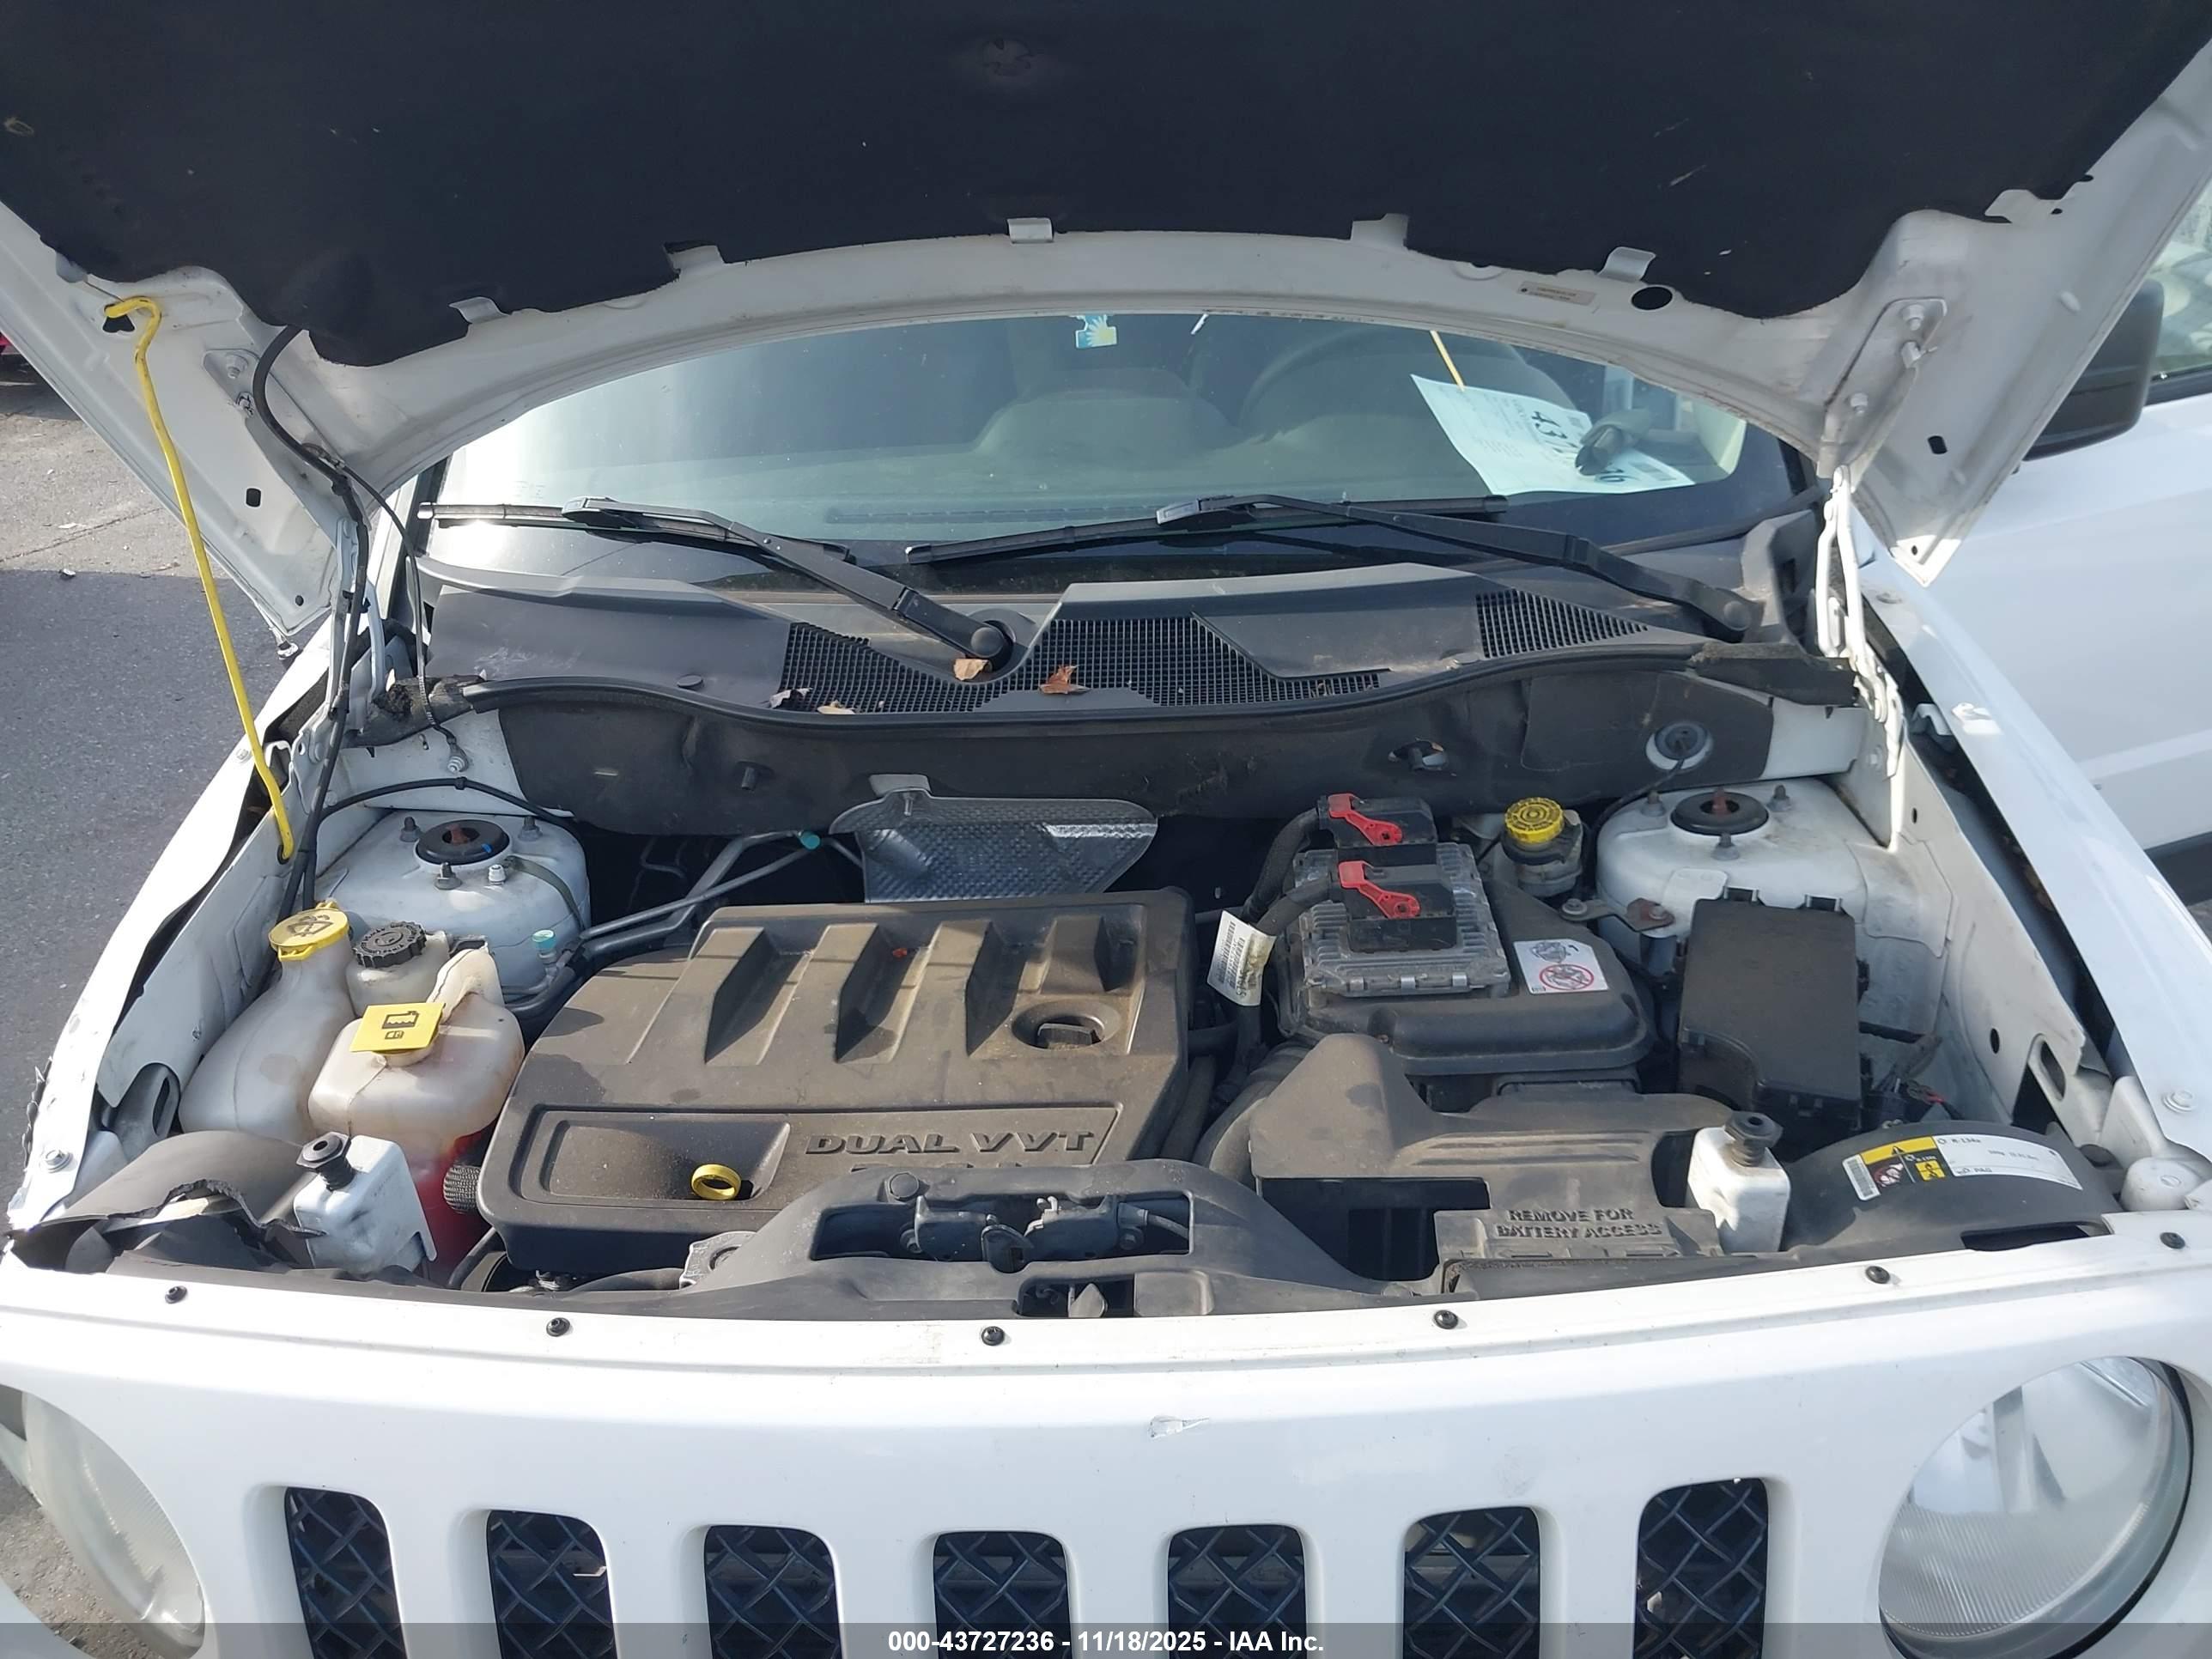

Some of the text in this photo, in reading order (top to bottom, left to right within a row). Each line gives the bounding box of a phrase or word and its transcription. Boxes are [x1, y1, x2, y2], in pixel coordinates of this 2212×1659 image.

[805, 1132, 1094, 1154] DUAL VVT
[1508, 1208, 1634, 1222] REMOVE FOR
[1496, 1223, 1662, 1238] BATTERY ACCESS
